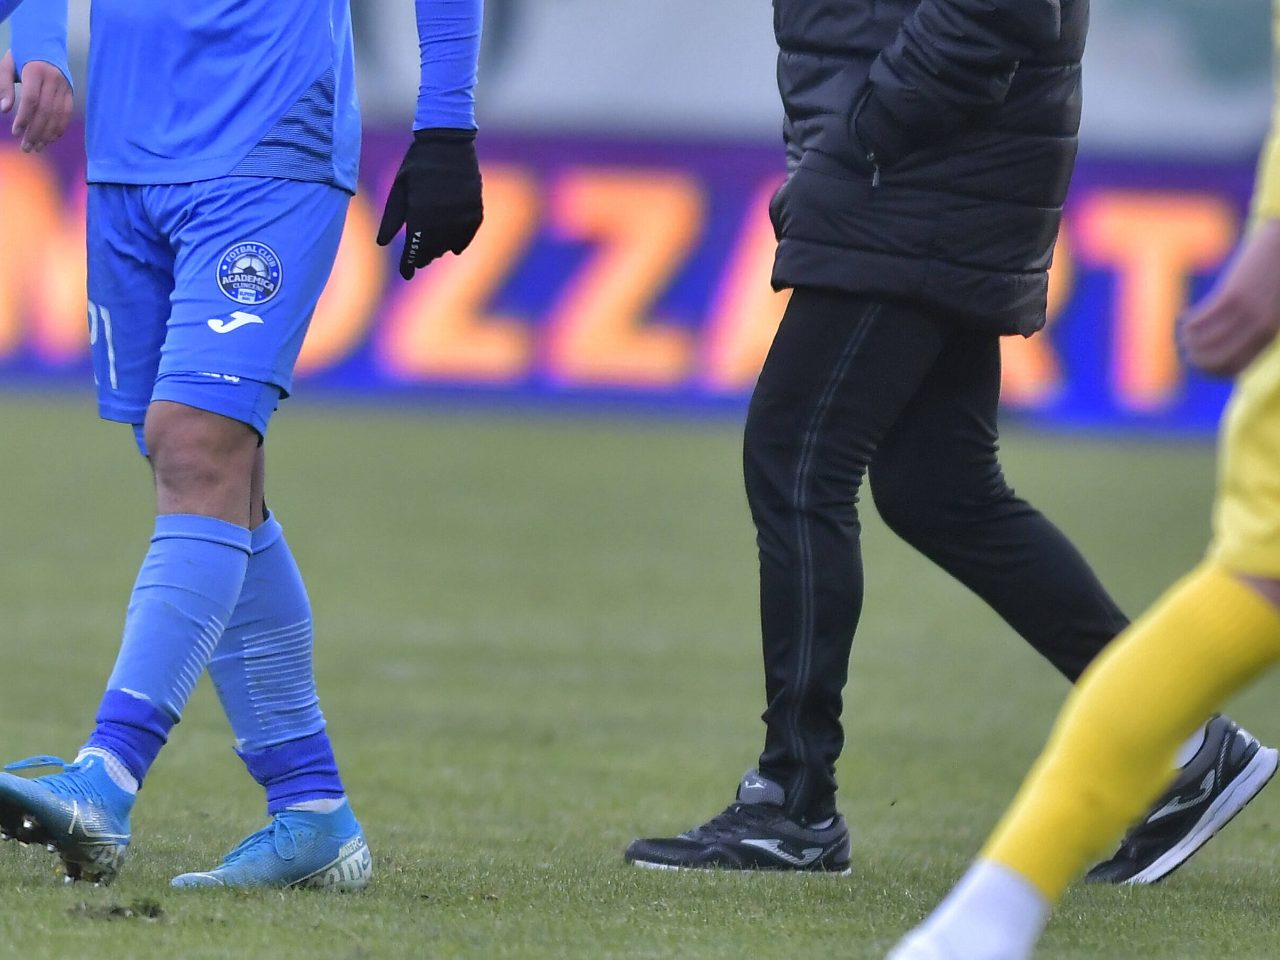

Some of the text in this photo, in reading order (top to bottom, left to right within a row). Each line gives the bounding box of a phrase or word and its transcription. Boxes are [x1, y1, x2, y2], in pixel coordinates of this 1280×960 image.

[225, 245, 277, 268] FOTBAL CLUB
[222, 274, 275, 292] ACADEMICA
